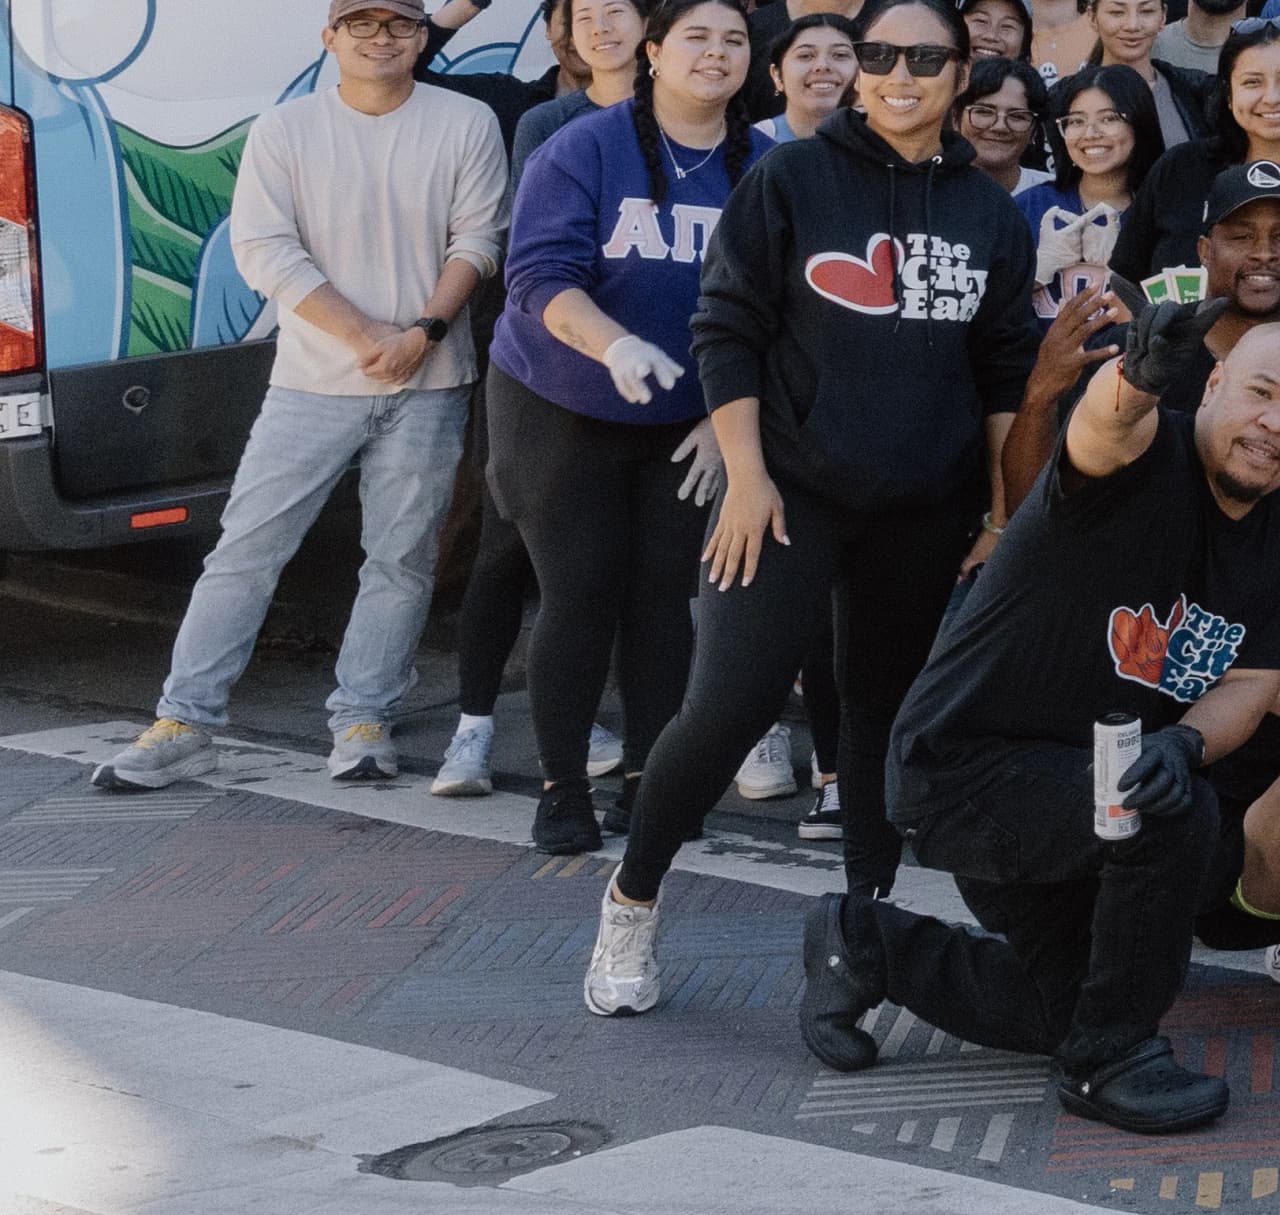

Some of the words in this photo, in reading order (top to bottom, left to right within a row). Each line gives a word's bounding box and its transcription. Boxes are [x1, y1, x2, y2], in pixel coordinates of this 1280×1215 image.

[907, 233, 971, 261] The
[901, 255, 990, 300] City
[1184, 604, 1246, 644] The
[1166, 626, 1239, 678] Cit
[1157, 656, 1208, 702] Ea
